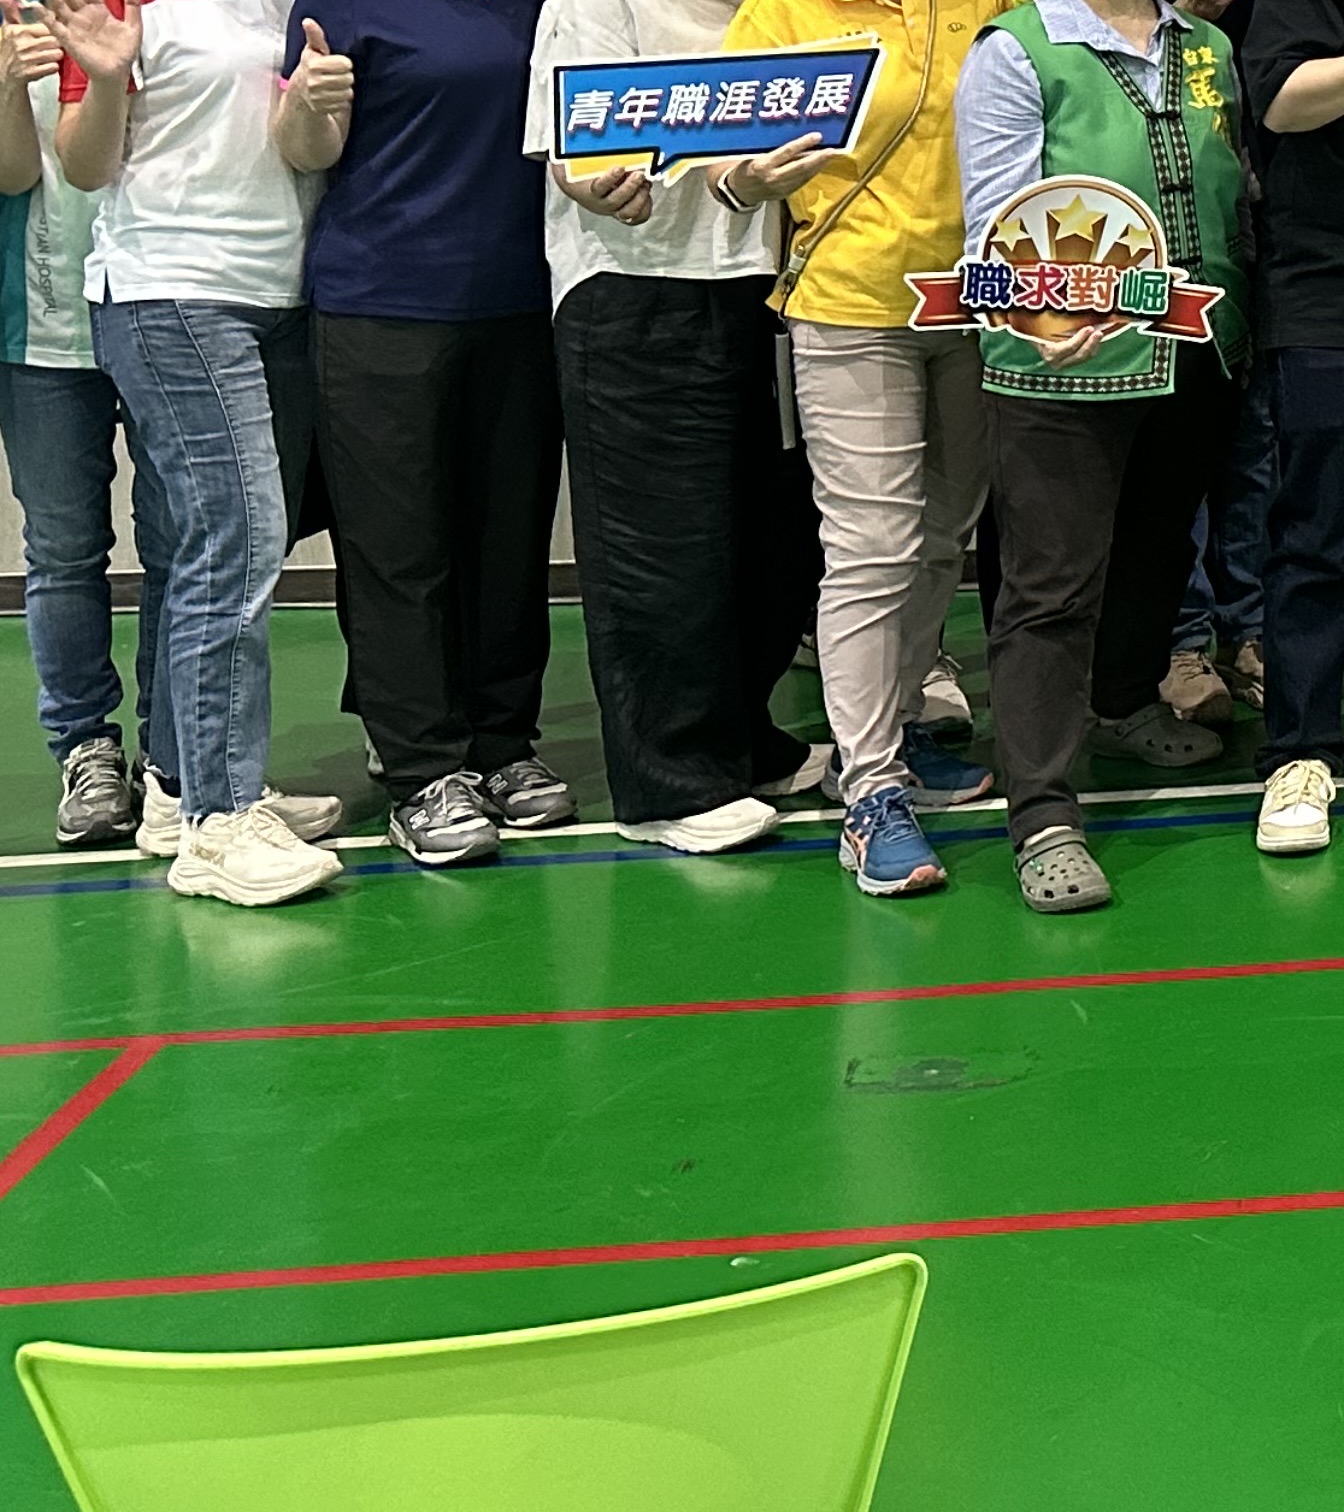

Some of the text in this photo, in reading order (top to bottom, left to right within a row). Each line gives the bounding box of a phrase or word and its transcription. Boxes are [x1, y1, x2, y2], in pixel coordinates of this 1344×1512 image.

[566, 73, 854, 133] 青年職涯發展
[961, 262, 1170, 314] 職求對崛
